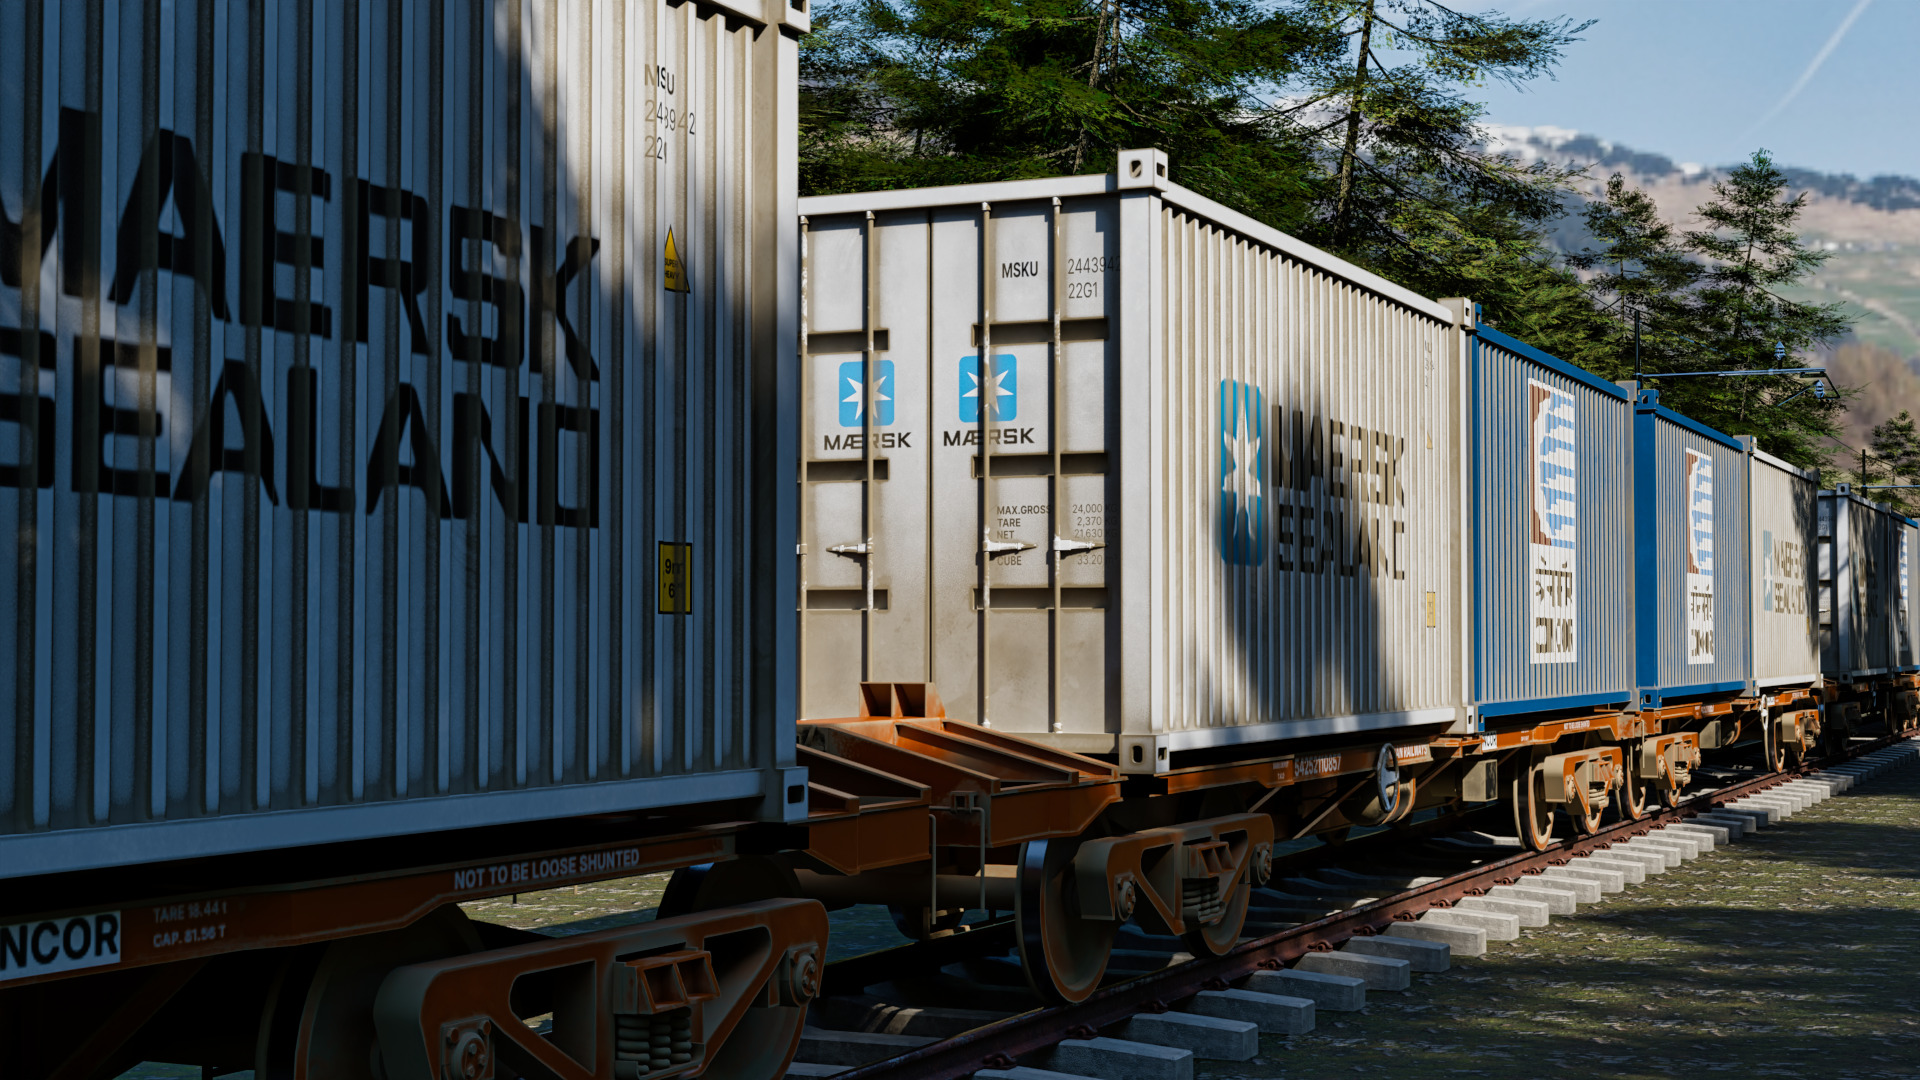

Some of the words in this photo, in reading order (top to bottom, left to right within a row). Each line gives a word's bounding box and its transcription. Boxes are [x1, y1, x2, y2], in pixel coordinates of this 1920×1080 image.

[1001, 260, 1039, 279] MSKU
[1068, 281, 1098, 299] 22G1
[0, 326, 600, 528] SEALAND
[996, 504, 1051, 516] MAX.GROSS
[1072, 503, 1103, 515] 24,000
[997, 518, 1021, 528] TARE
[996, 530, 1015, 540] NET
[997, 555, 1022, 566] CUBE
[454, 866, 486, 891] NOT
[489, 864, 508, 886] TO
[511, 861, 529, 882] BE
[532, 857, 577, 880] LOOSE
[579, 848, 640, 873] SHUNTED
[153, 904, 185, 924] TARE
